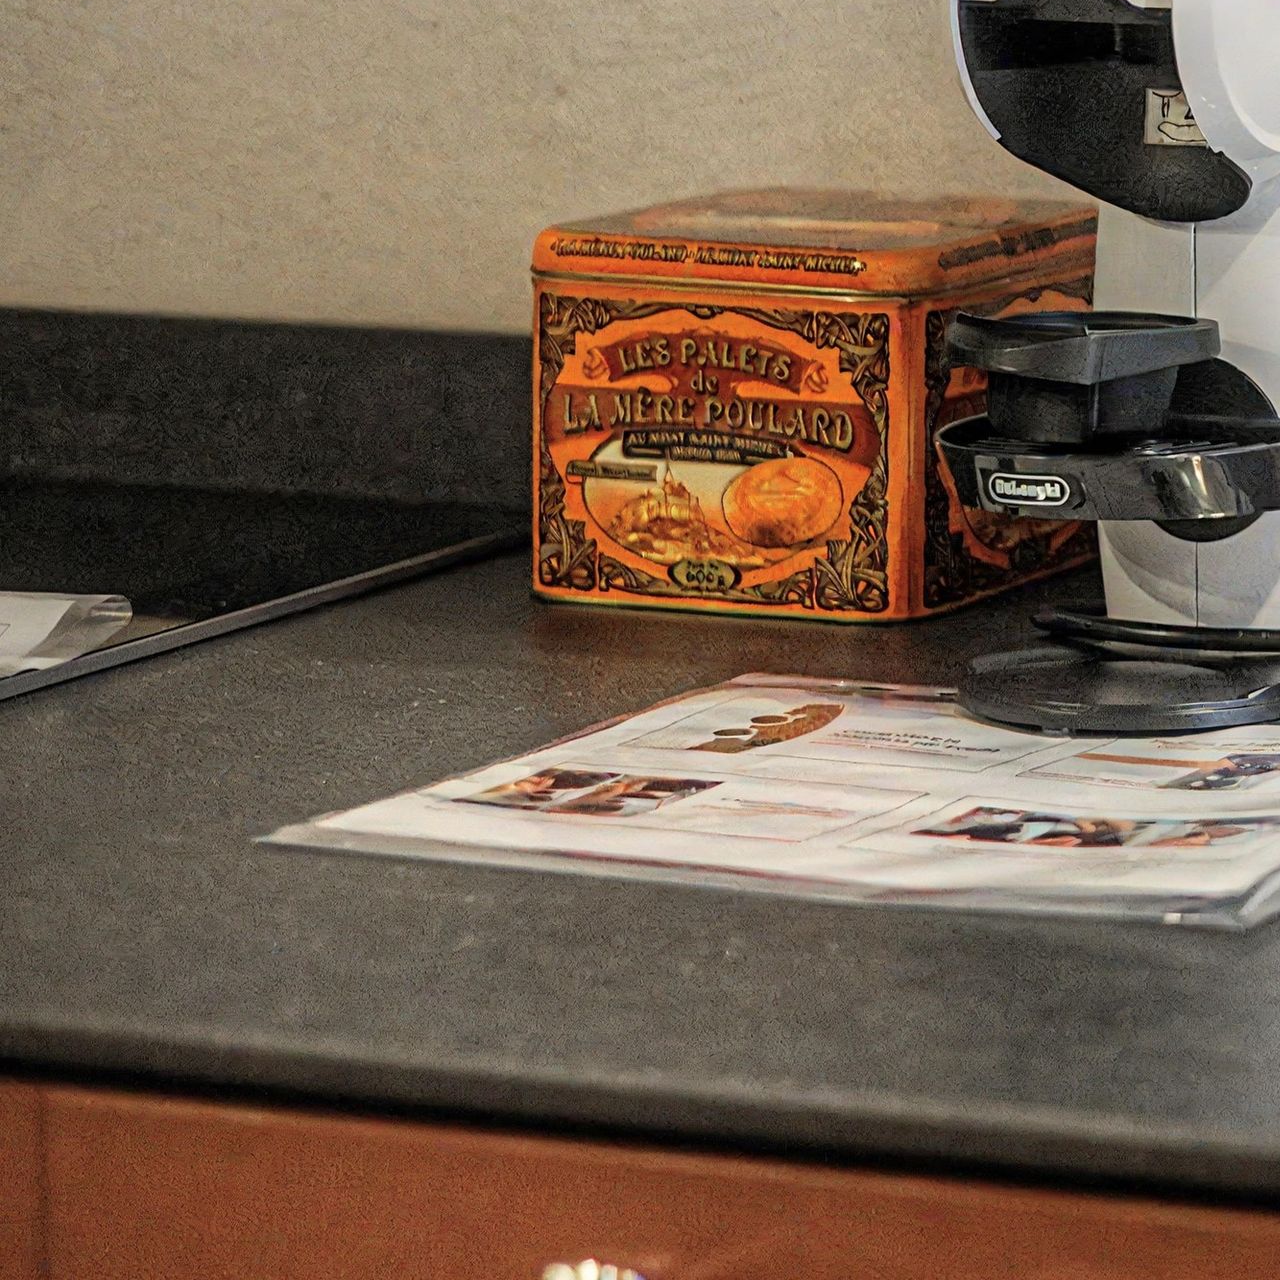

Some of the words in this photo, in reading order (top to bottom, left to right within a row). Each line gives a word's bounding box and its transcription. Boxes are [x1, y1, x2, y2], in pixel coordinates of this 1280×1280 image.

[618, 338, 671, 372] LES
[681, 338, 792, 381] PALETS
[690, 371, 719, 395] de
[563, 394, 604, 432] LA
[704, 397, 854, 451] POULARD
